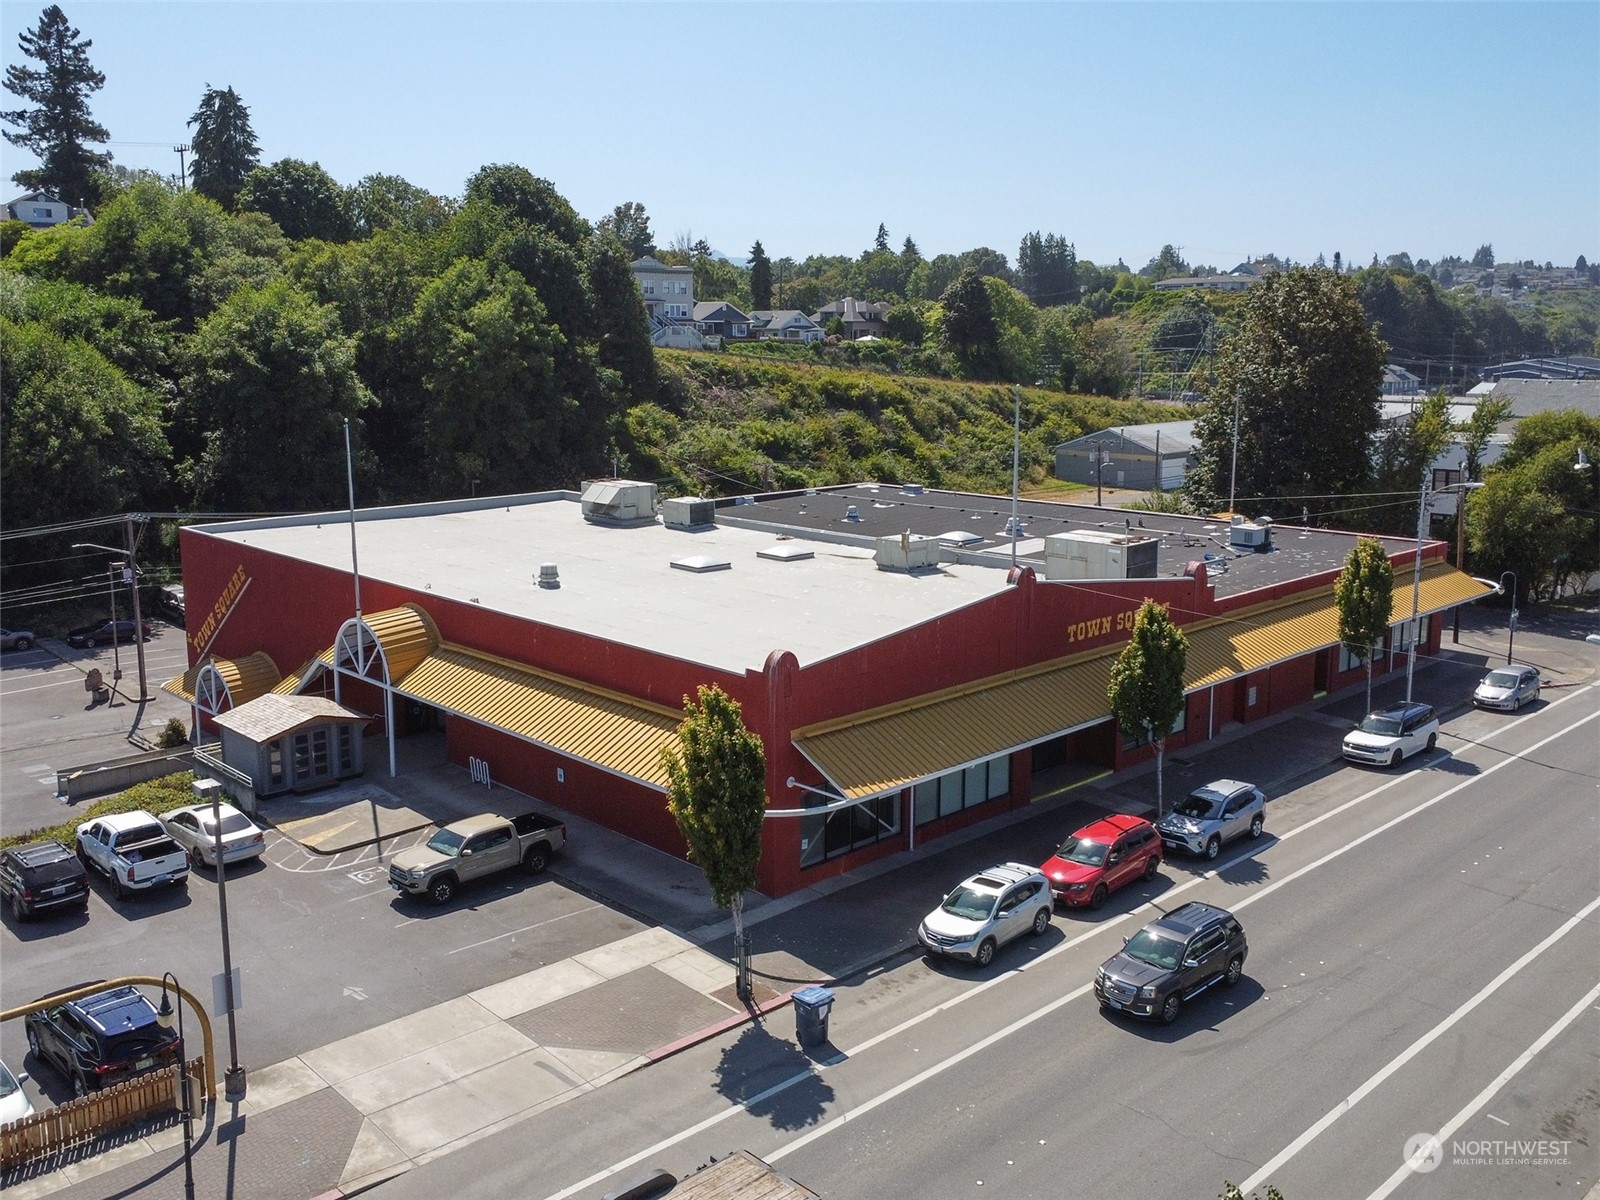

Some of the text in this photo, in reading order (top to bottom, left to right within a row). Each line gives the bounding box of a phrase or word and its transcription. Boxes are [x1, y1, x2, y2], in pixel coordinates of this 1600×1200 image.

[193, 564, 246, 653] TOWN SQUARE
[1067, 616, 1112, 642] TOWN
